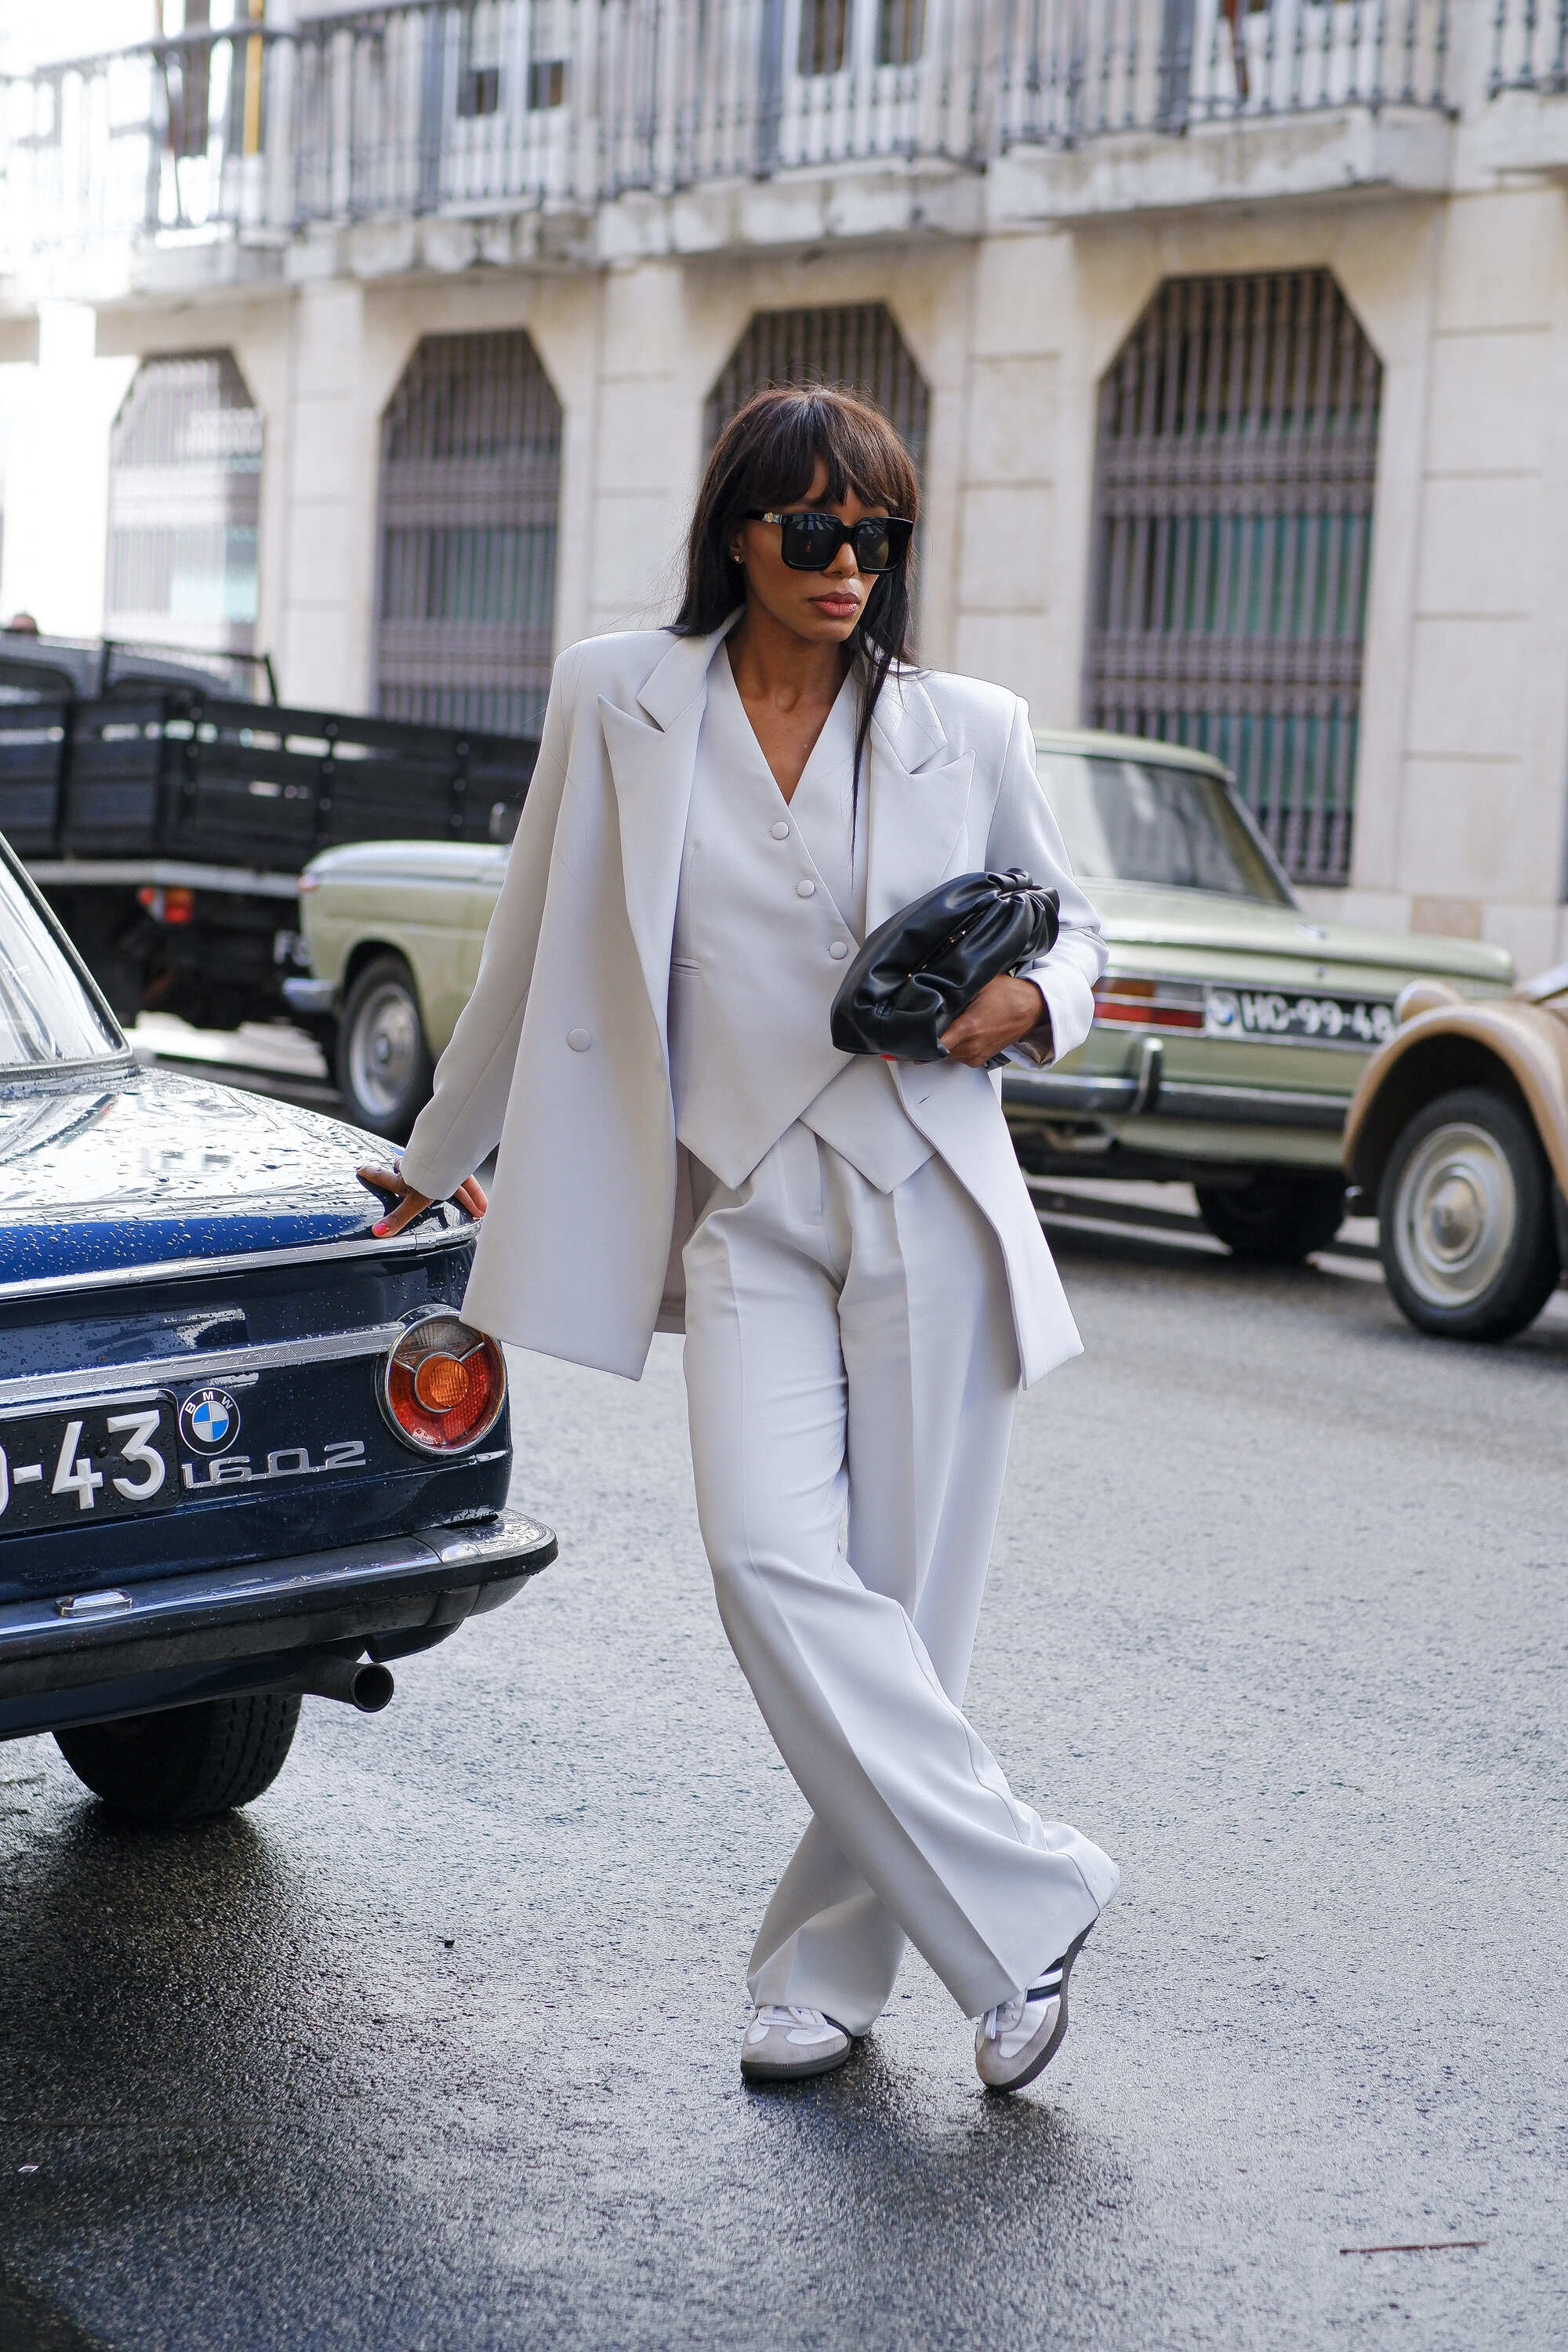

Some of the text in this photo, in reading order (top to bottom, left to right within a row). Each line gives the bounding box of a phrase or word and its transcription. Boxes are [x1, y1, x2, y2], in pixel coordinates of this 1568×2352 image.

[184, 1391, 234, 1415] BMW
[0, 1410, 165, 1516] -43
[181, 1440, 366, 1490] 1602
